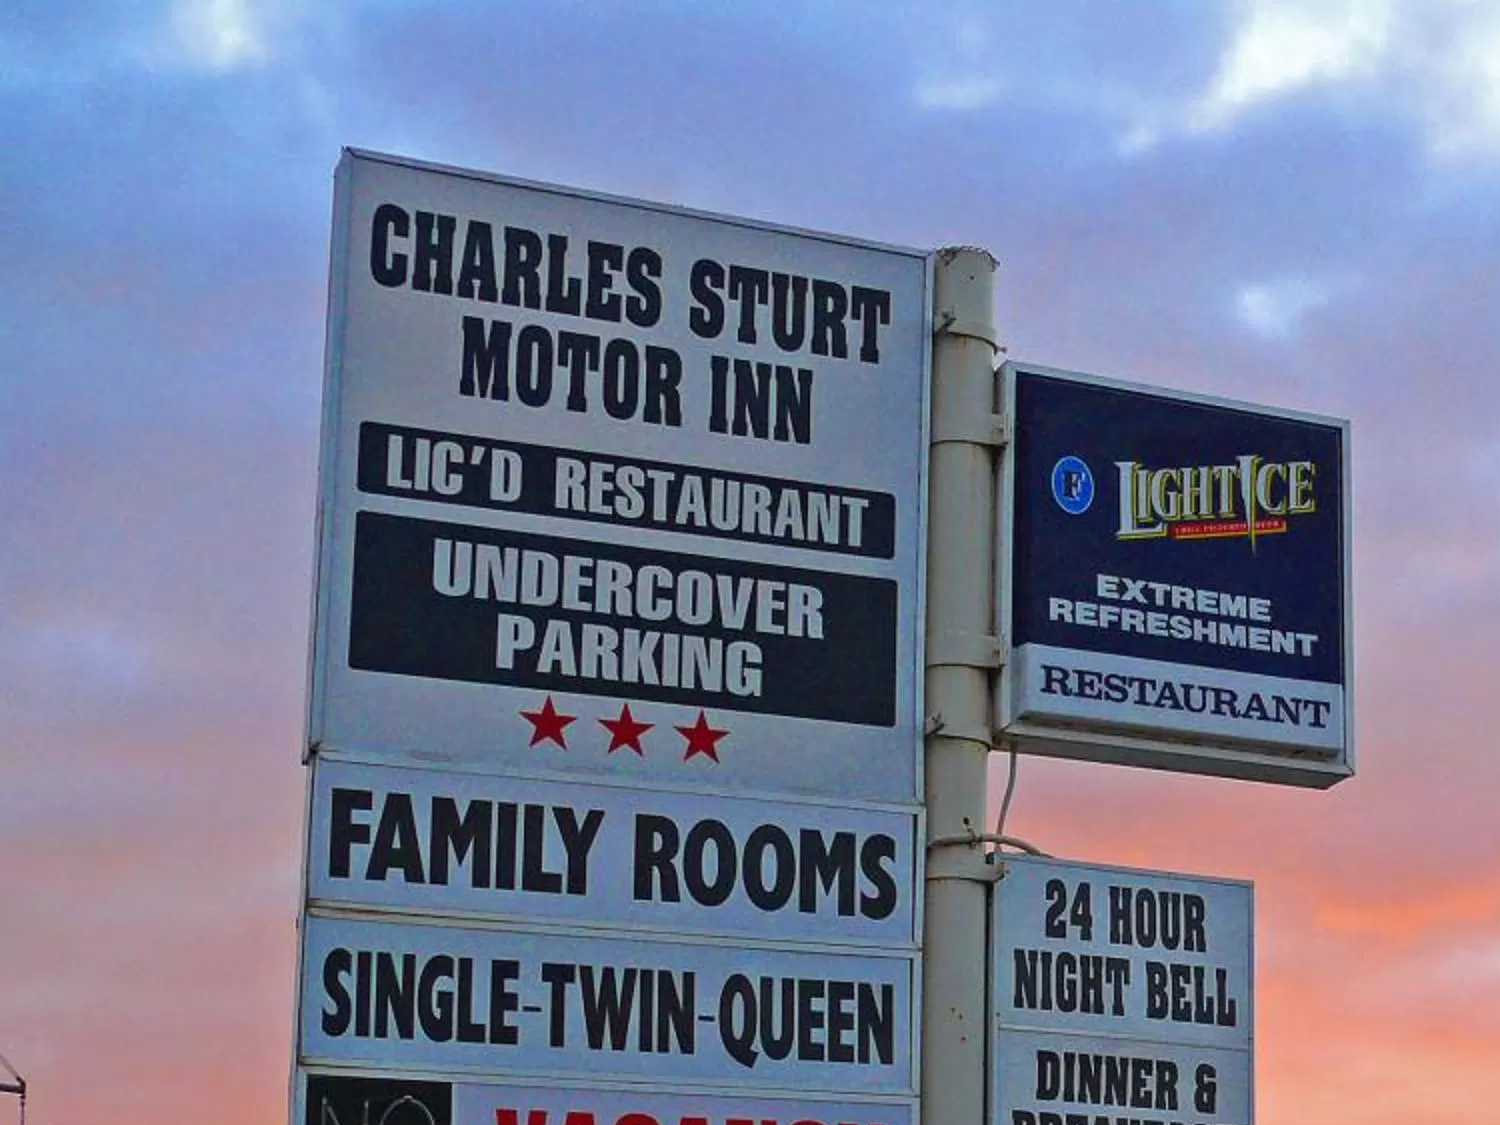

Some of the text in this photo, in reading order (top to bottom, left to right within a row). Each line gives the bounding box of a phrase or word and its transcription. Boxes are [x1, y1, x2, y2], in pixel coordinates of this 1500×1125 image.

[370, 203, 890, 364] CHARLES STURT
[460, 316, 813, 445] MOTOR INN
[386, 435, 868, 547] LIC'D RESTAURANT
[432, 538, 823, 639] UNDERCOVER
[1049, 597, 1318, 657] REFRESHMENT
[1096, 574, 1271, 623] EXTREME
[496, 612, 763, 697] PARKING
[1040, 664, 1331, 728] RESTAURANT
[329, 788, 897, 920] FAMILY ROOMS
[1045, 879, 1207, 952] 24 HOUR
[1013, 948, 1237, 1027] NIGHT BELL
[1035, 1049, 1217, 1114] DINNER &
